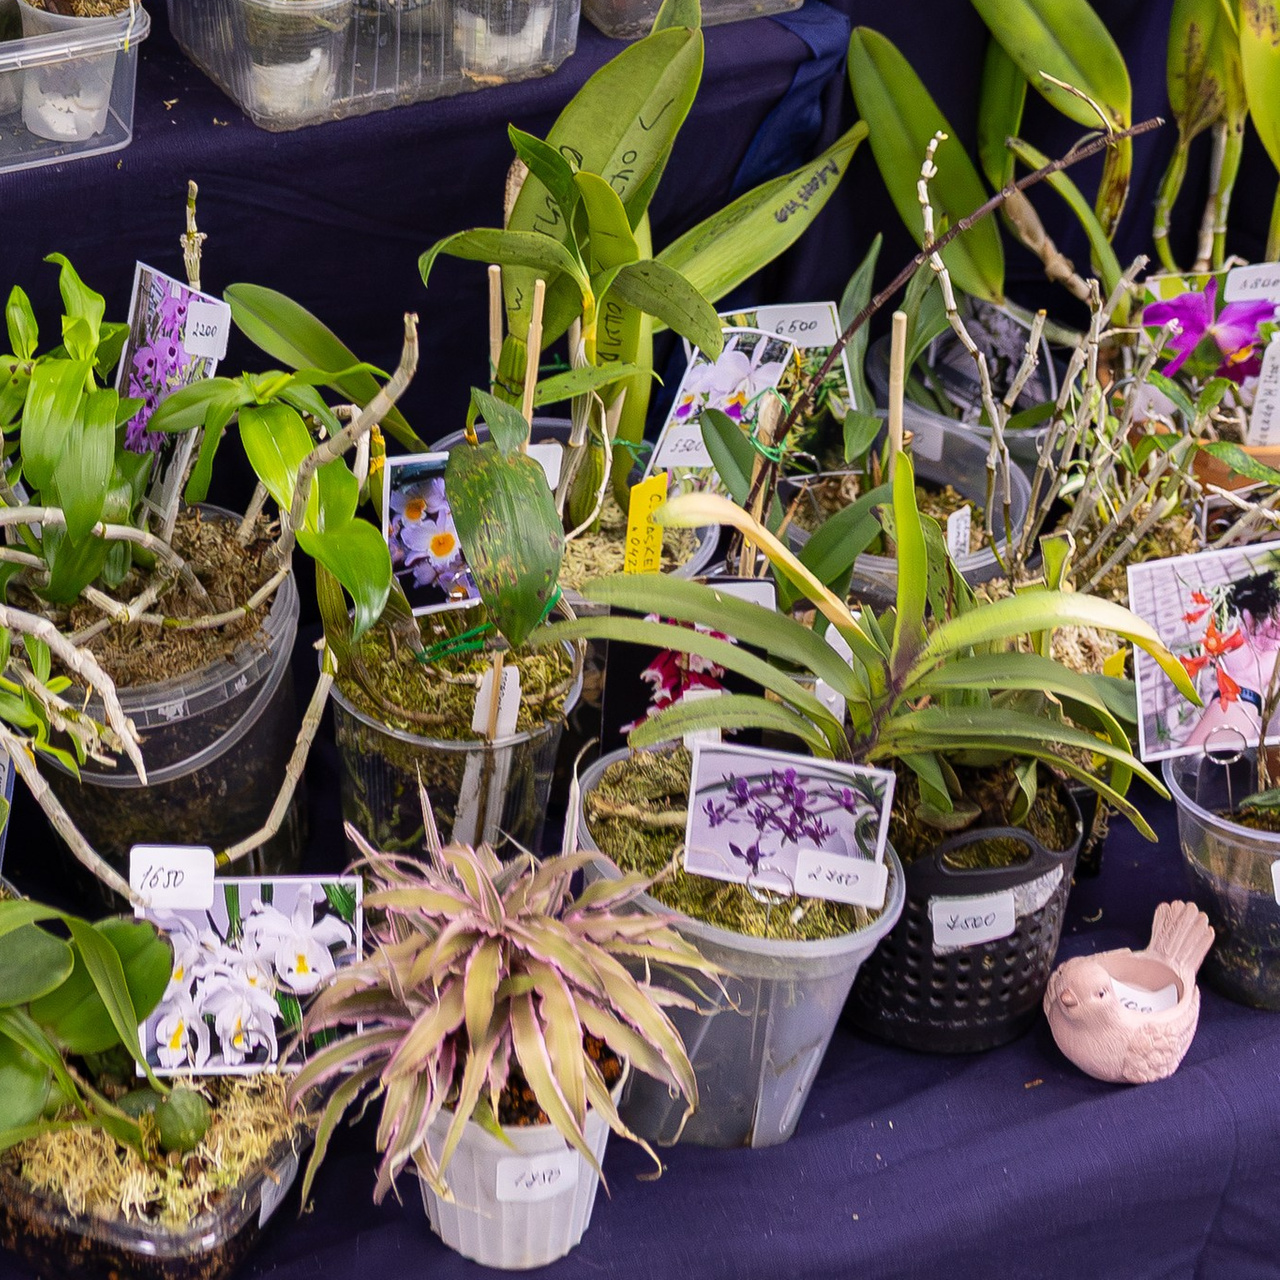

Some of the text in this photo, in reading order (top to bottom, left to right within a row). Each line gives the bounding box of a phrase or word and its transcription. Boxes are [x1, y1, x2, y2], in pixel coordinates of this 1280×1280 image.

[192, 321, 218, 338] 2200
[775, 319, 818, 335] 6500
[140, 864, 185, 891] 1650
